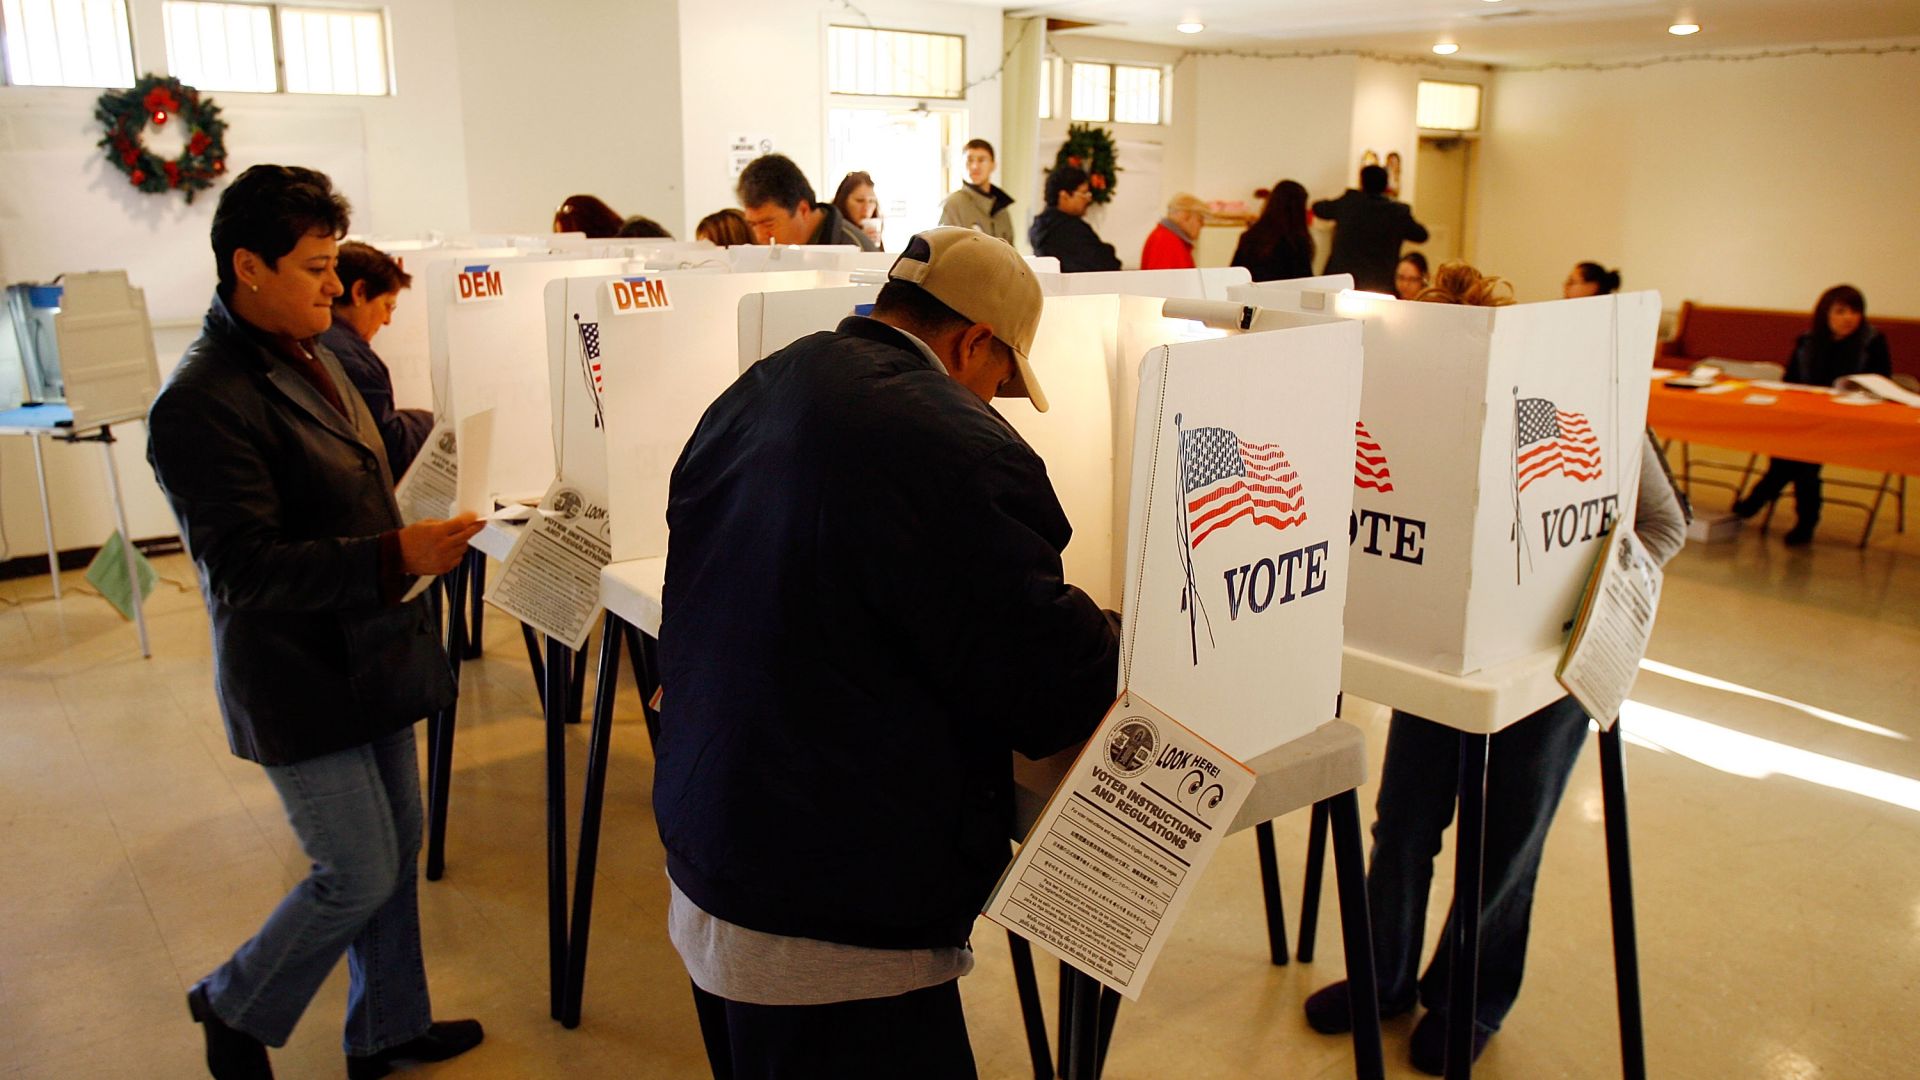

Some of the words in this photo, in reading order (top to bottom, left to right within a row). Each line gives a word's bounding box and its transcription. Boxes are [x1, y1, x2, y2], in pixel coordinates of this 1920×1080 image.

[458, 271, 503, 298] DEM
[613, 279, 669, 310] DEM
[584, 503, 607, 519] LOOK
[1541, 494, 1619, 552] VOTE
[567, 529, 612, 561] INSTRUCTION
[1223, 540, 1329, 621] VOTE
[1156, 744, 1192, 770] LOOK
[1190, 753, 1220, 779] HERE!
[1091, 784, 1116, 803] AND
[1115, 799, 1188, 849] REGULATIONS
[1092, 766, 1127, 795] VOTER
[1127, 789, 1202, 843] INSTRUCTIONS
